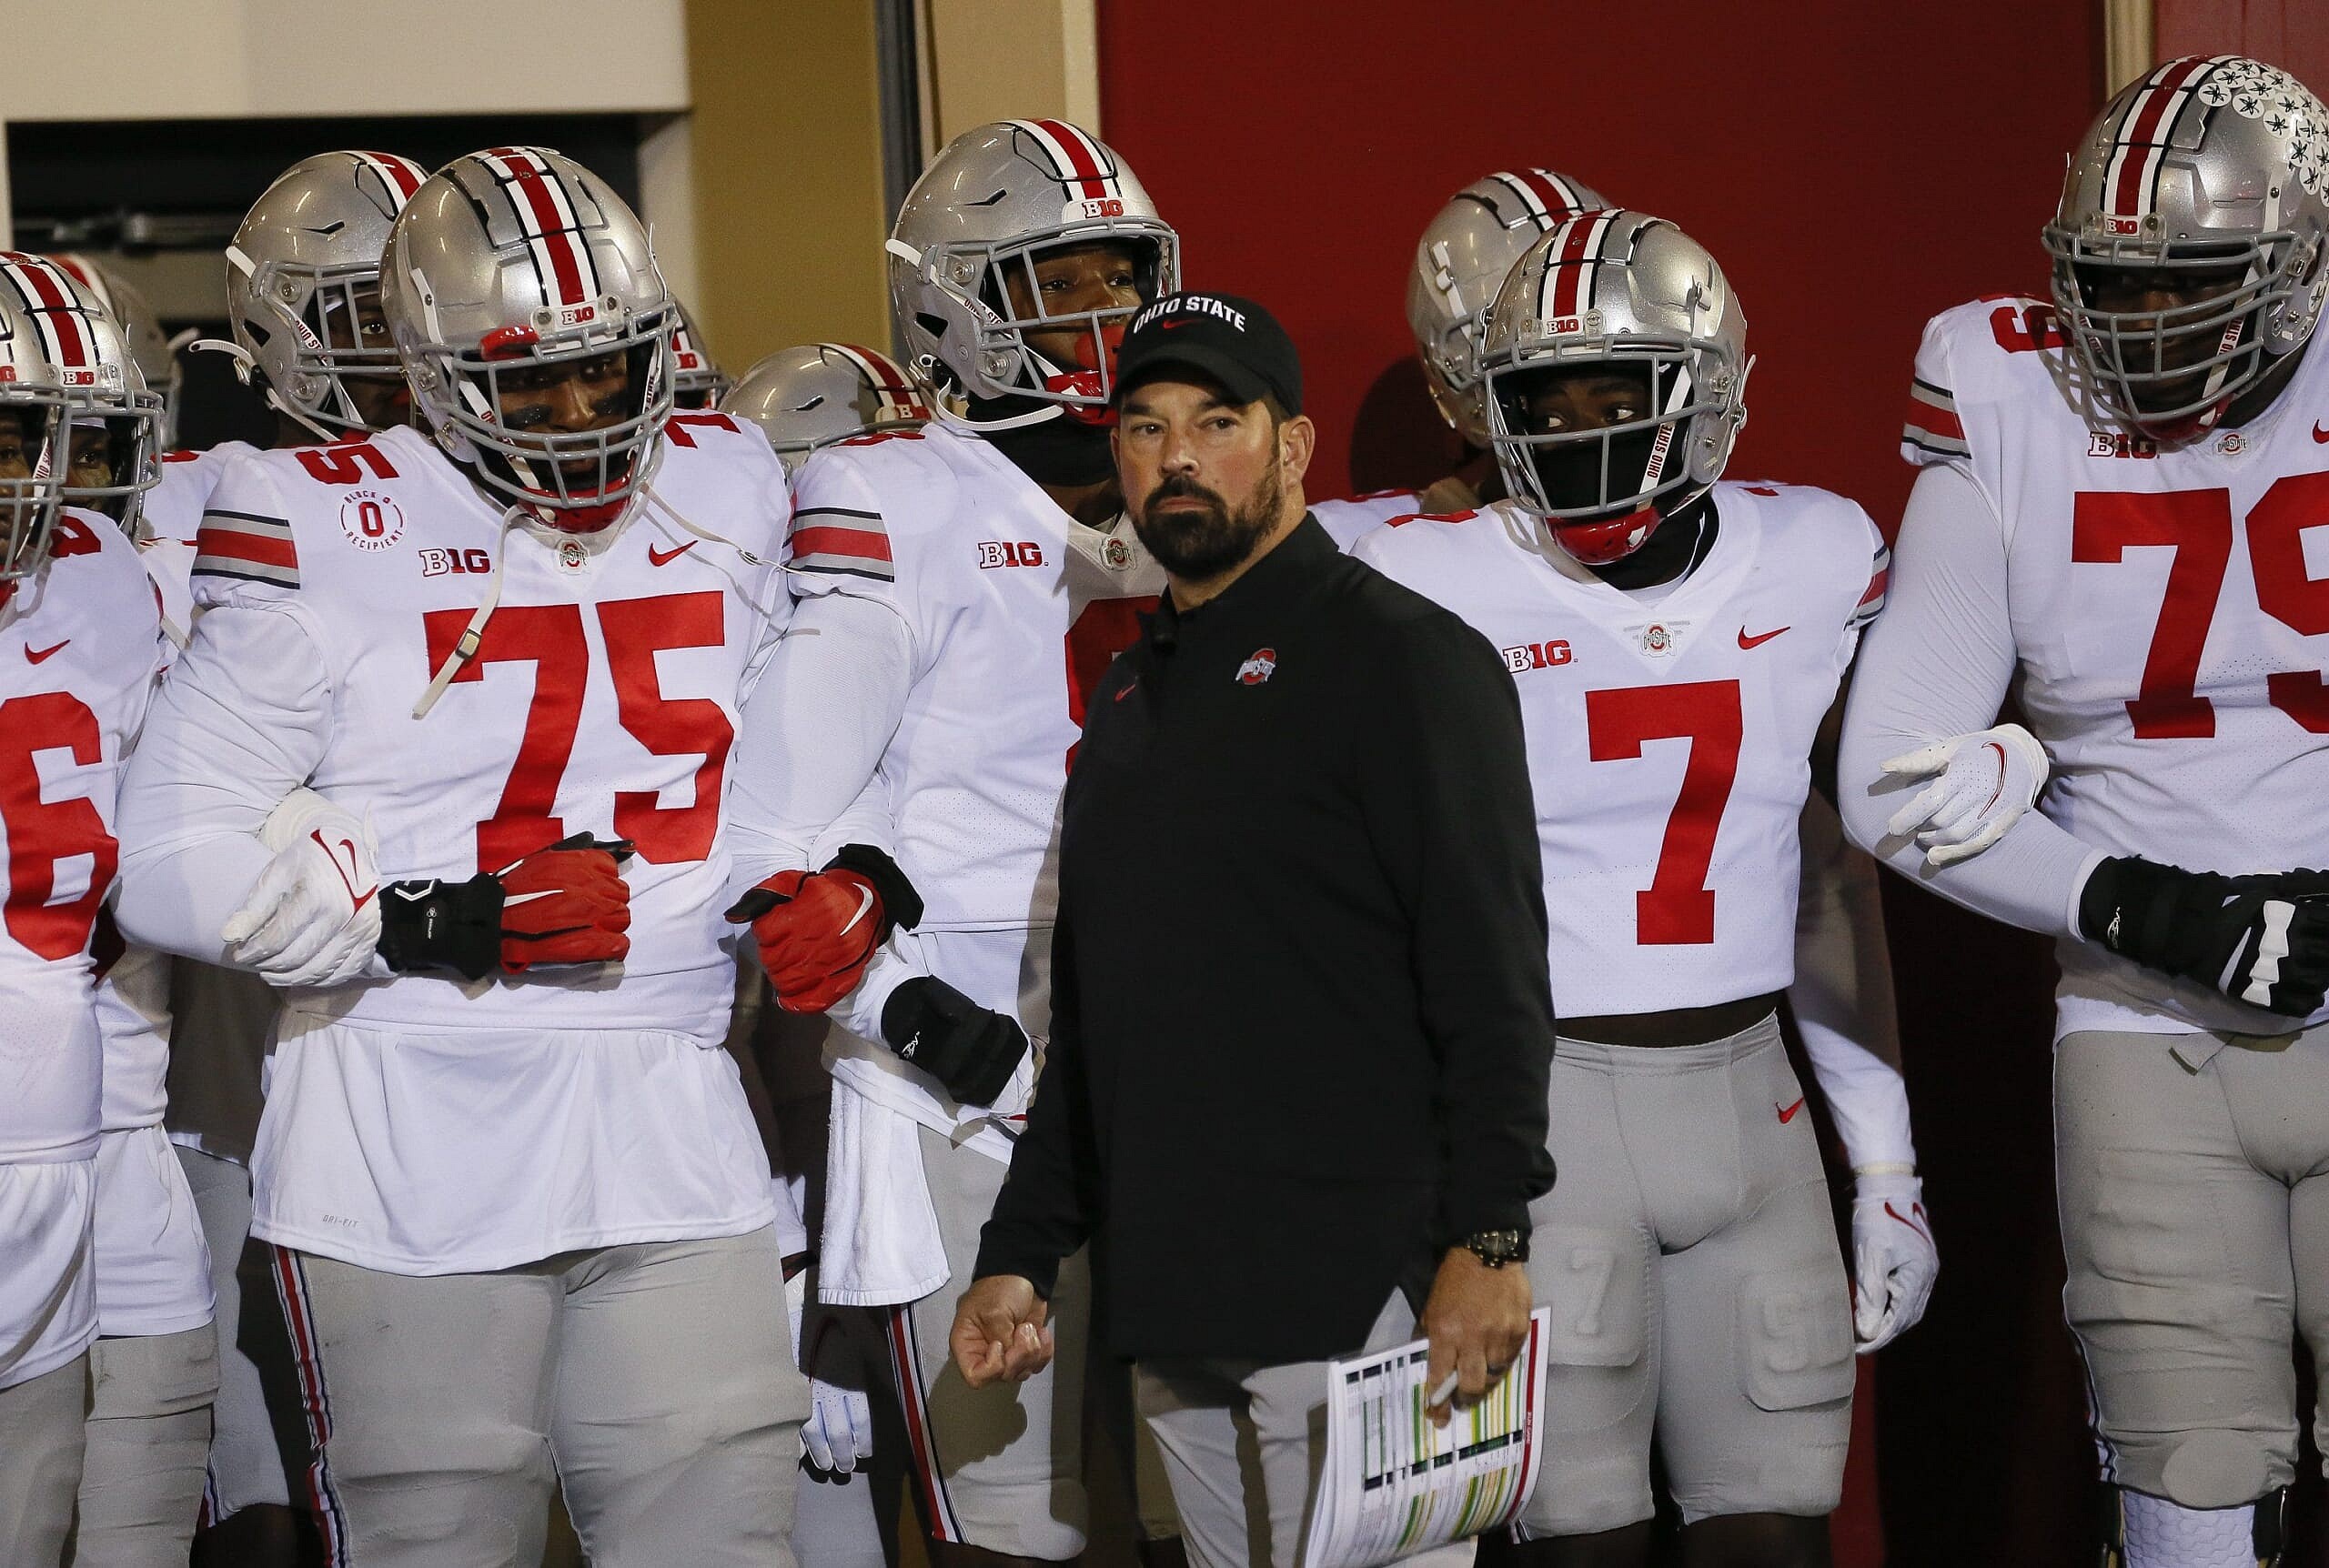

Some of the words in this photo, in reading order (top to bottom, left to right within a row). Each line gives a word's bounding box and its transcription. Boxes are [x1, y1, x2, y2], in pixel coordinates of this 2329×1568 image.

[1134, 297, 1181, 334] OHIO
[1185, 296, 1245, 333] STATE
[1647, 454, 1663, 478] OHIO
[1655, 424, 1673, 453] STATE
[344, 490, 376, 503] BLOCK
[346, 529, 403, 550] RECIPIENT
[423, 590, 734, 873] 75
[0, 691, 119, 961] 6
[1585, 679, 1743, 945] 7
[322, 1214, 359, 1228] DRI-FIT
